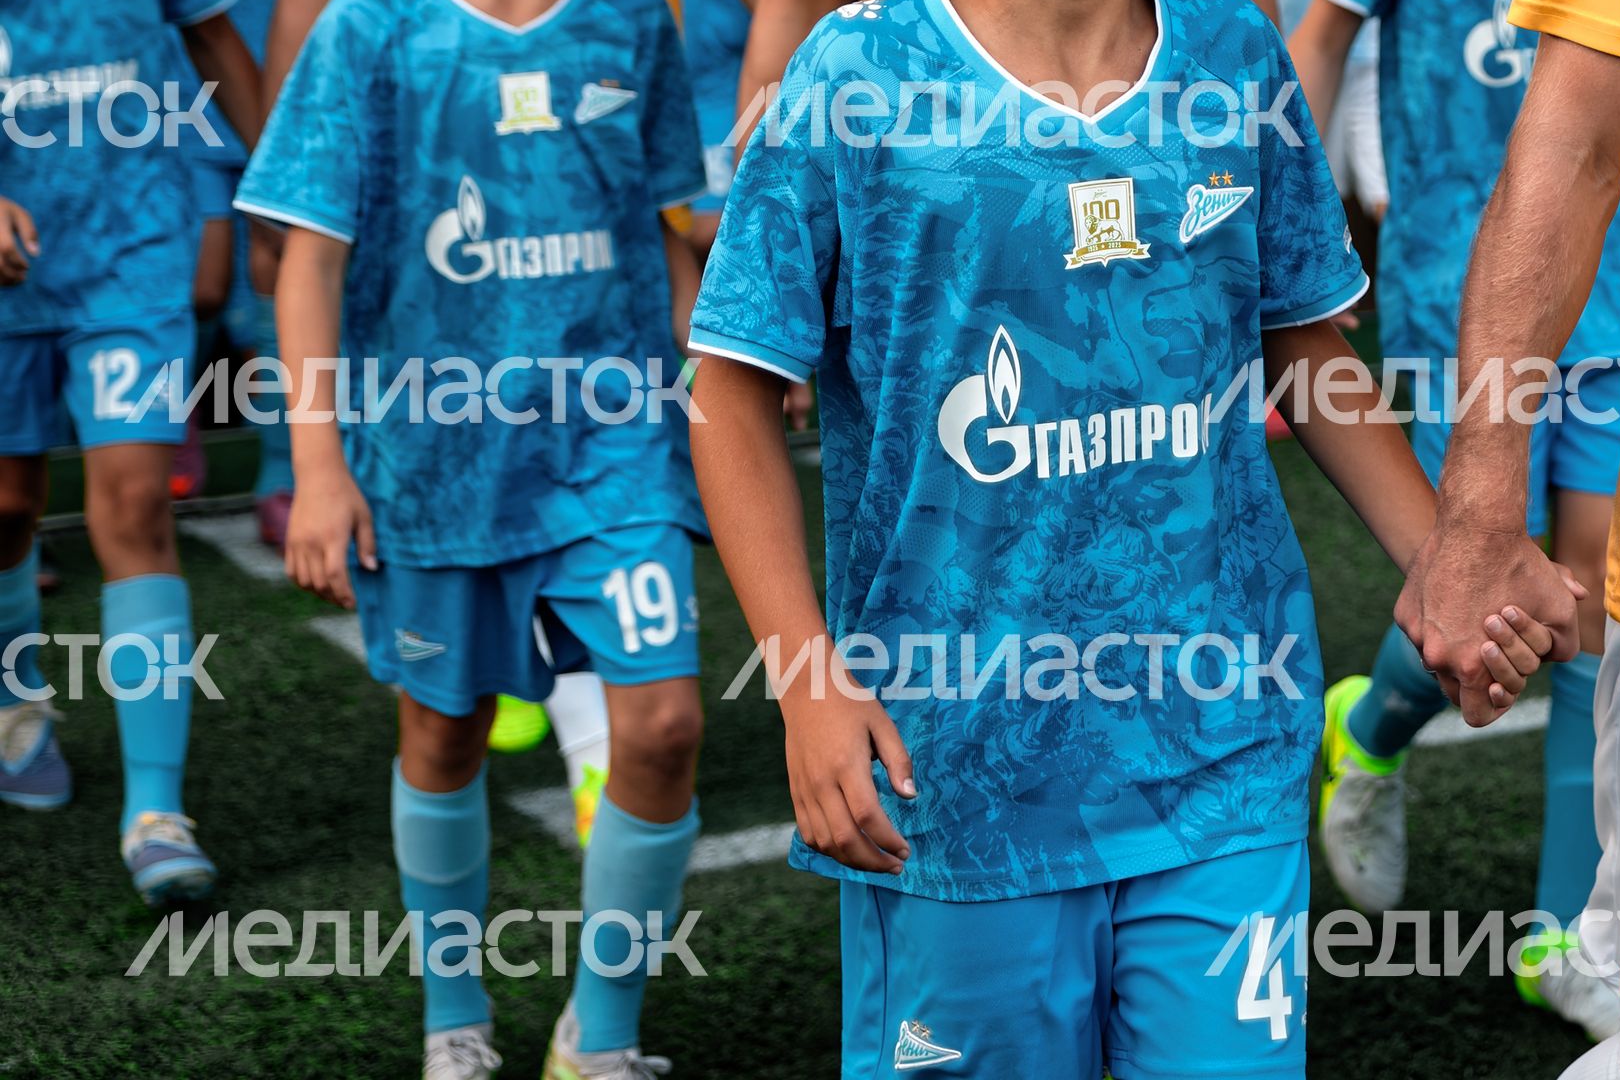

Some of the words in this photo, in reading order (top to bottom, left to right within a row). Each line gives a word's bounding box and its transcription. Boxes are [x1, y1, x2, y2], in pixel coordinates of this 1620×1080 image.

[88, 347, 141, 421] 12
[602, 561, 680, 654] 19
[1237, 916, 1293, 1041] 4
